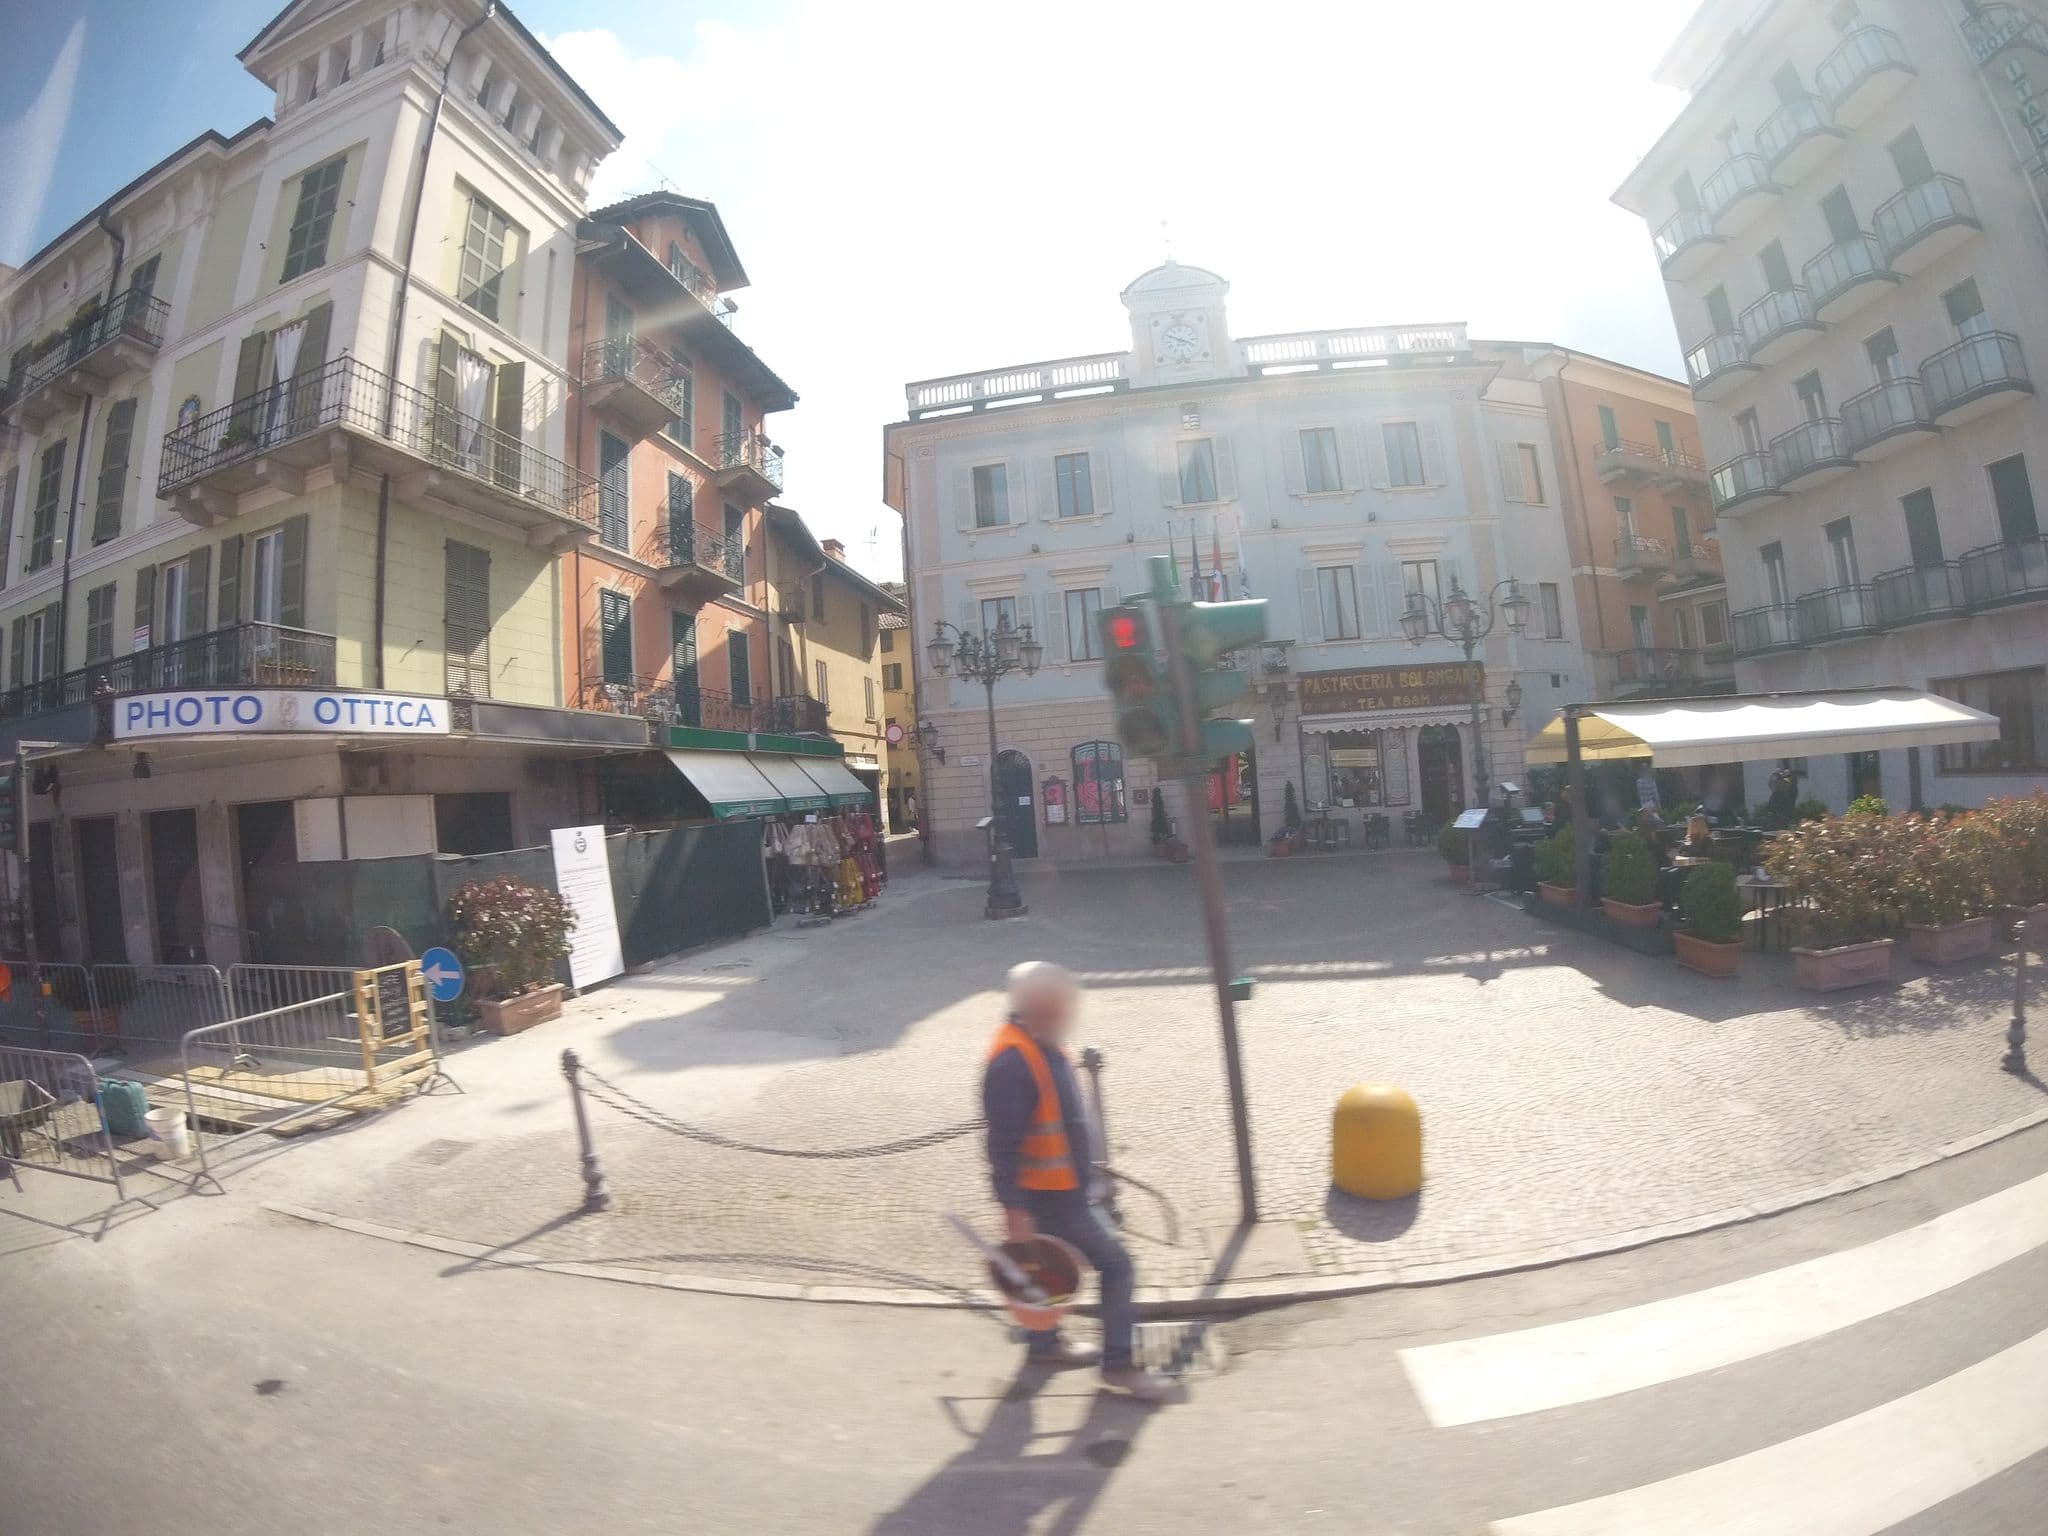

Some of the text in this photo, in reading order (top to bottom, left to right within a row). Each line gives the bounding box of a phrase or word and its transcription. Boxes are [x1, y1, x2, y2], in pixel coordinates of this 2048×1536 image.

[1975, 12, 2028, 61] HOTEL
[1304, 673, 1393, 694] PASTICCERIA
[127, 695, 436, 730] PHOTO OTTICA
[1358, 694, 1431, 710] TEA ROOM
